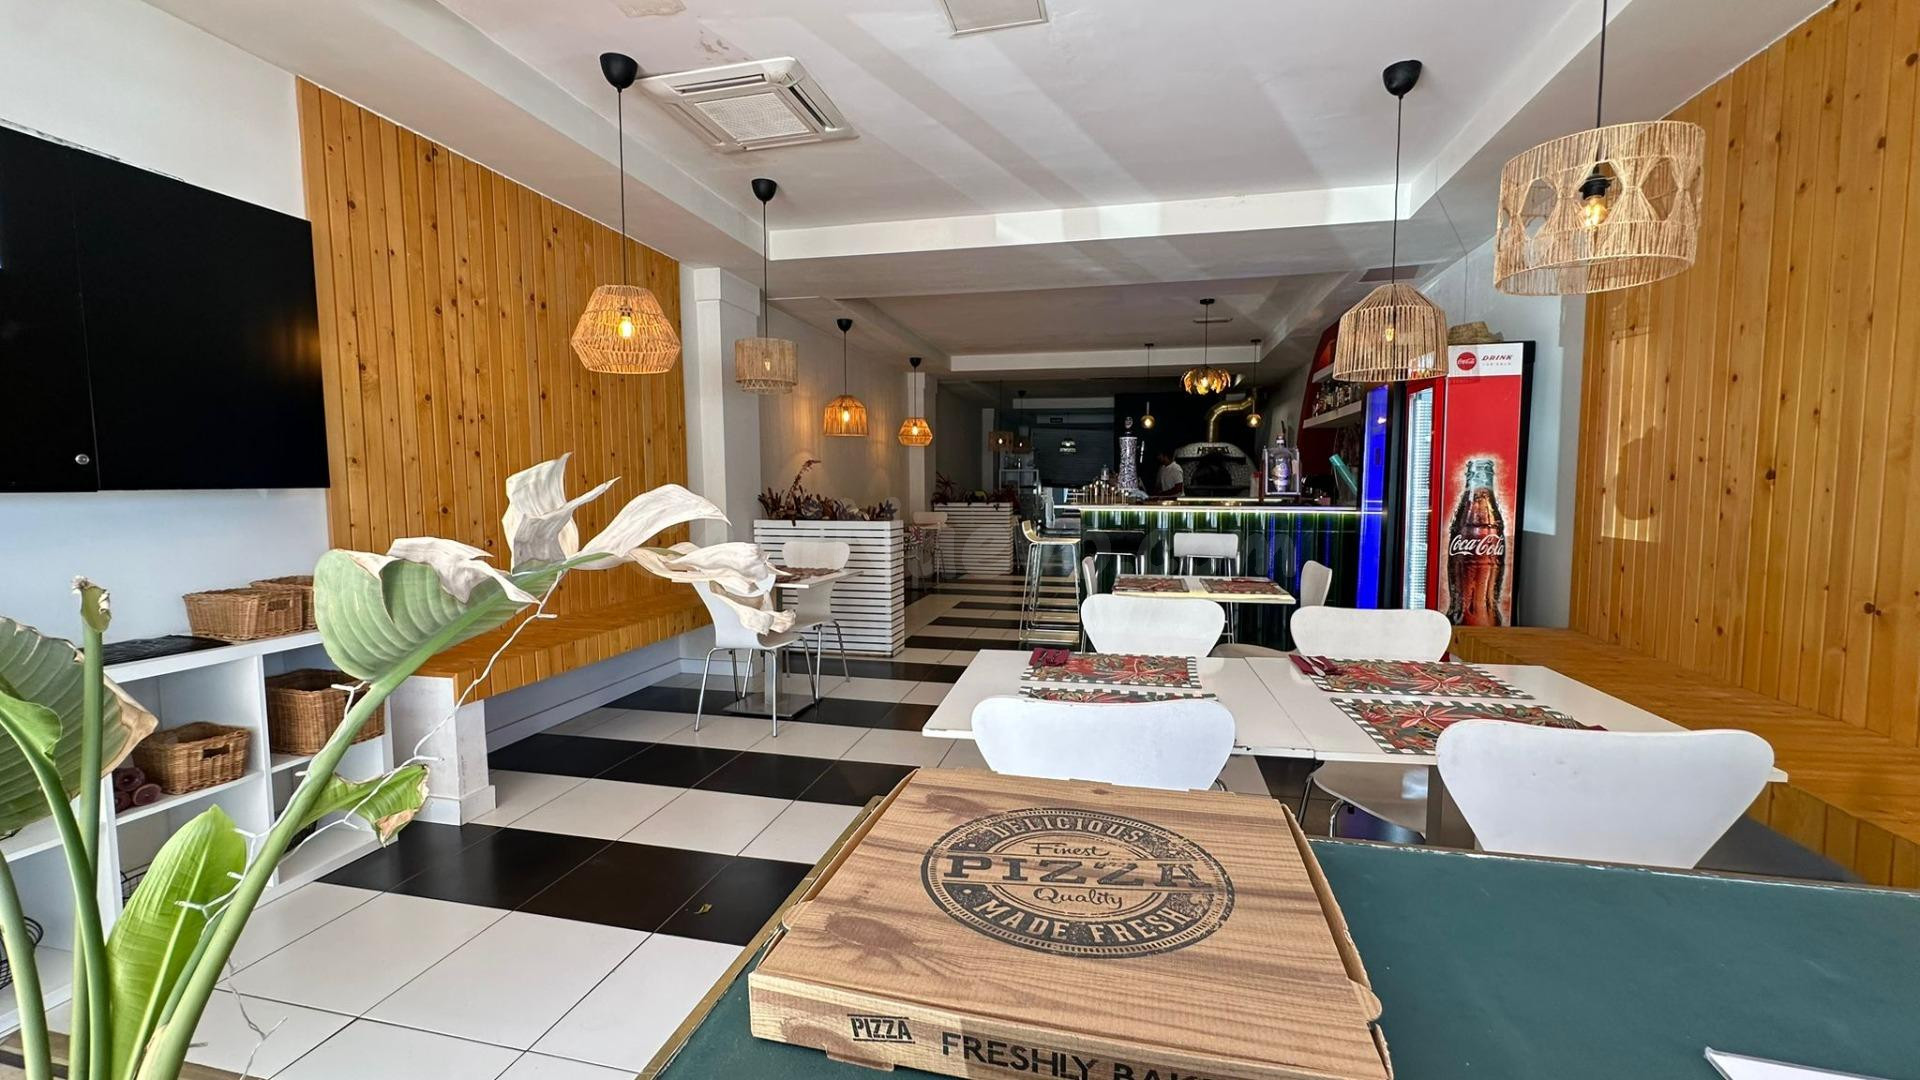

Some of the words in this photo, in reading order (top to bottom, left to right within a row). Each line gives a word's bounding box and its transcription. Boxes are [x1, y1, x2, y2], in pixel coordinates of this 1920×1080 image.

[1449, 534, 1504, 556] Coca-Cola
[988, 816, 1145, 843] DELICIOUS
[1029, 842, 1110, 857] Finest
[943, 855, 1213, 888] PIZZA
[1032, 887, 1124, 909] Quality
[972, 898, 1070, 940] MADE
[1091, 905, 1192, 944] FRESH
[851, 1017, 912, 1041] PIZZA
[941, 1031, 1099, 1080] FRESHLY
